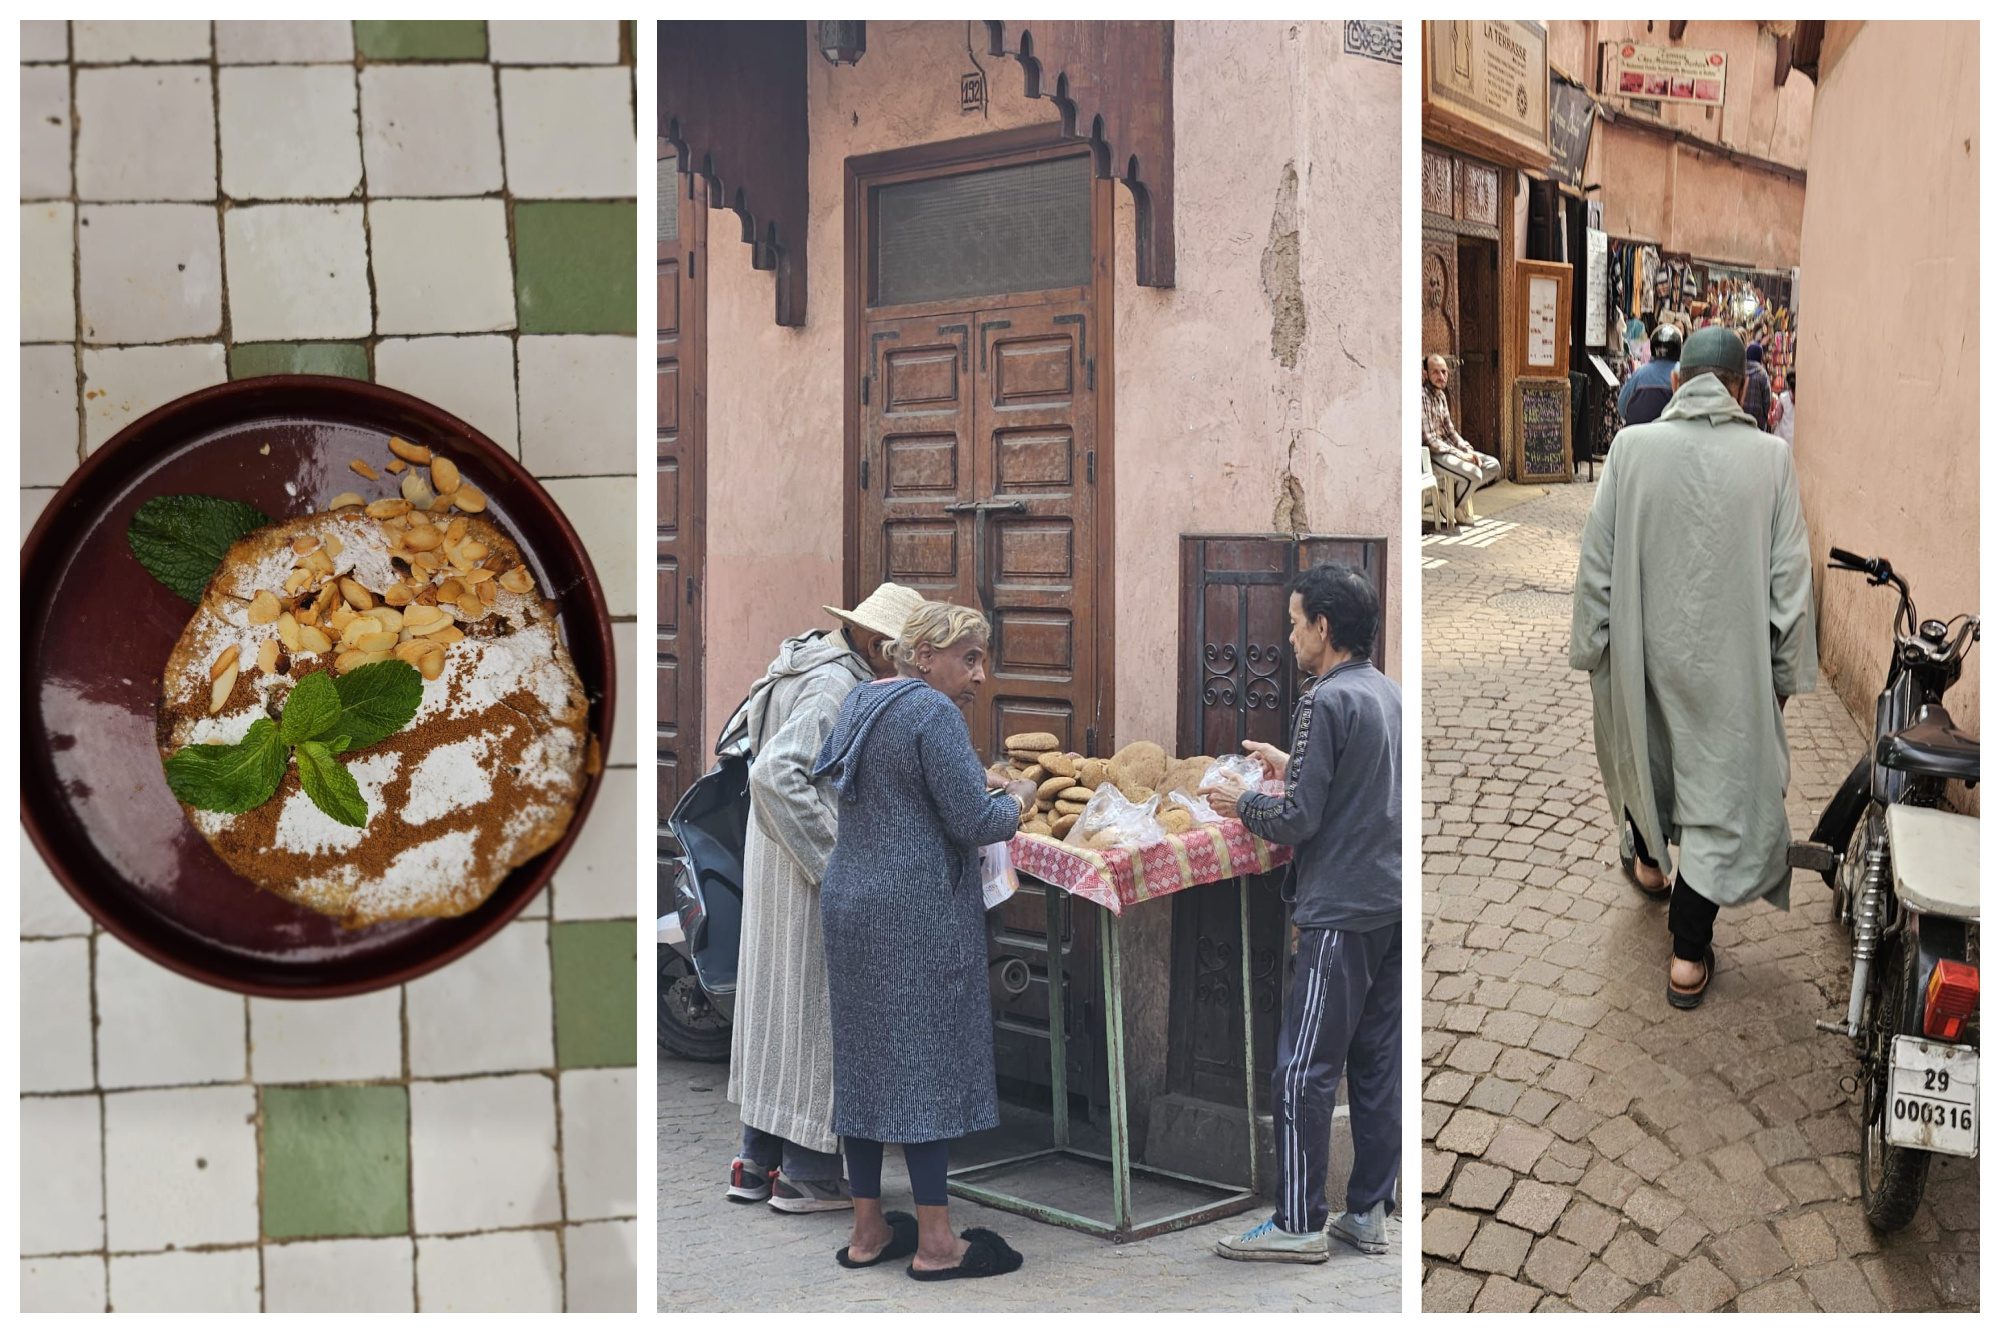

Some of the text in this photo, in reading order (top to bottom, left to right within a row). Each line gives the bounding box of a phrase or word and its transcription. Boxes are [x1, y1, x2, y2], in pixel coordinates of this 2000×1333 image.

[1483, 22, 1493, 41] LA
[1494, 28, 1527, 63] TERRASSE
[1924, 1068, 1949, 1092] 29
[1894, 1098, 1972, 1131] 000316
